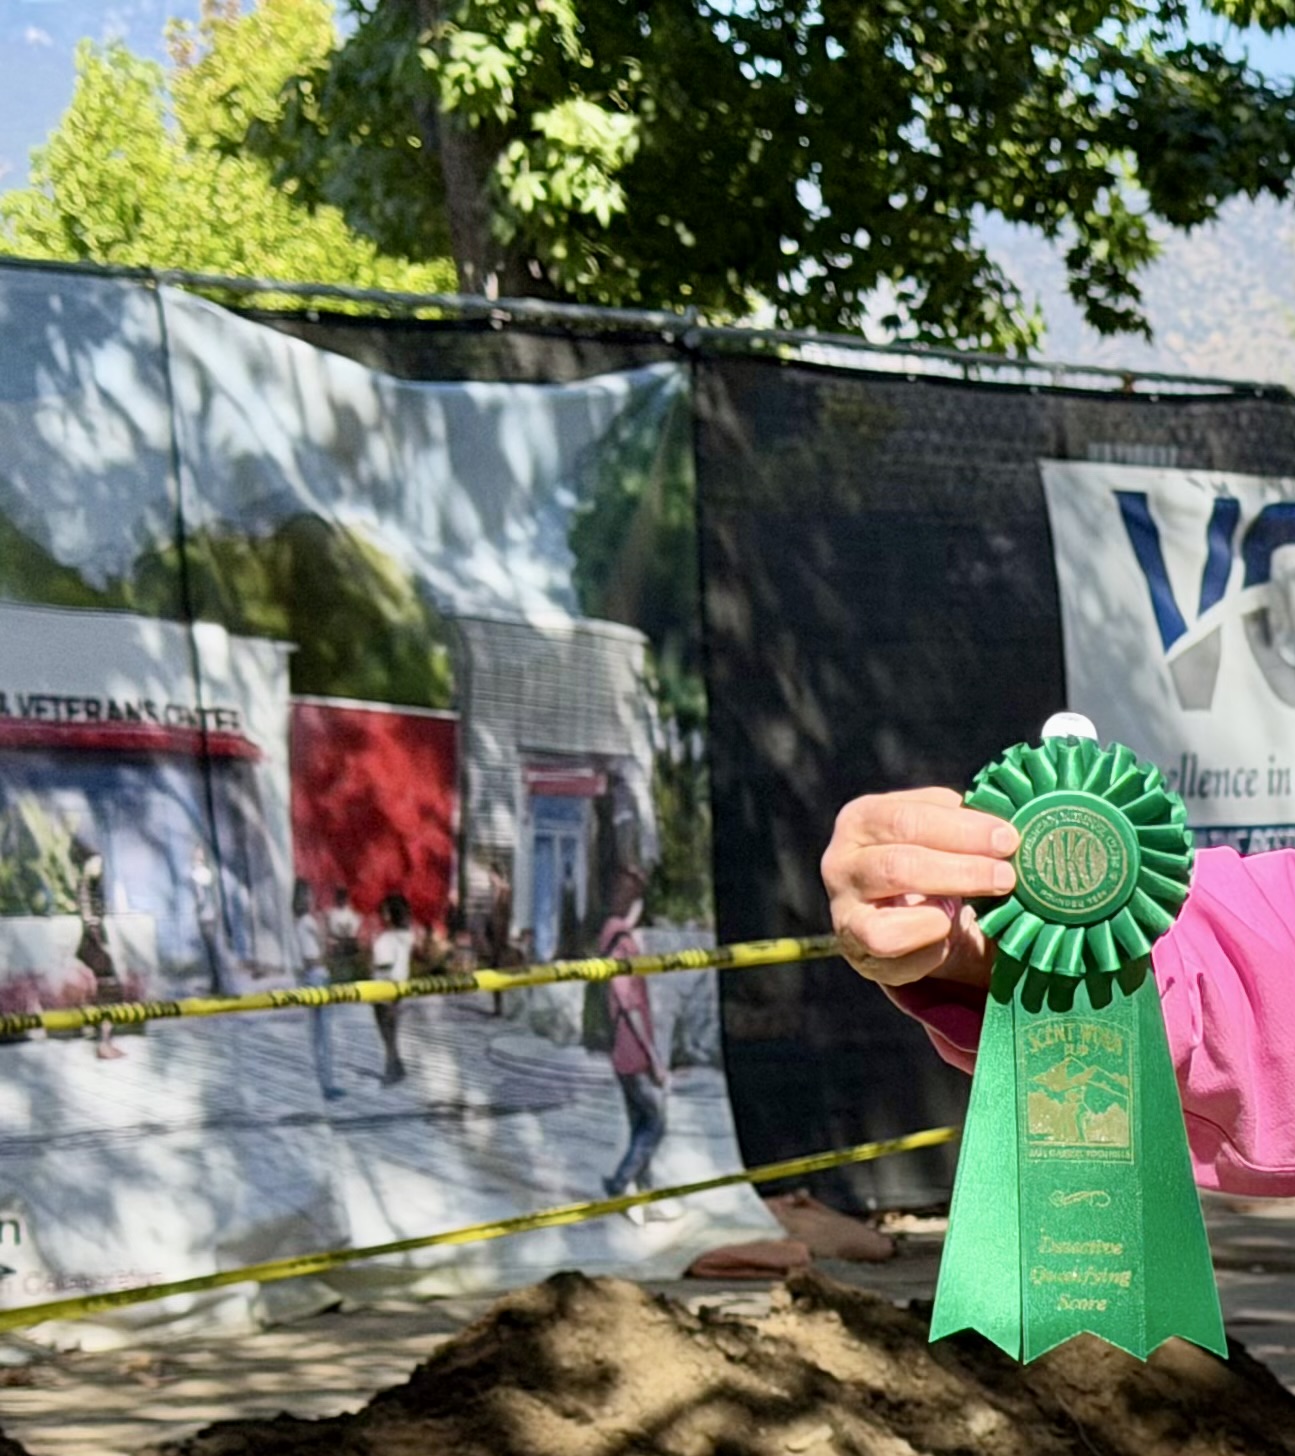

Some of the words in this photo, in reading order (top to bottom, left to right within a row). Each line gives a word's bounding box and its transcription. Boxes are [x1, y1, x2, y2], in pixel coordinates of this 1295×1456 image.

[17, 692, 159, 723] VETERANS
[1167, 751, 1259, 800] ellence
[1267, 753, 1291, 797] in
